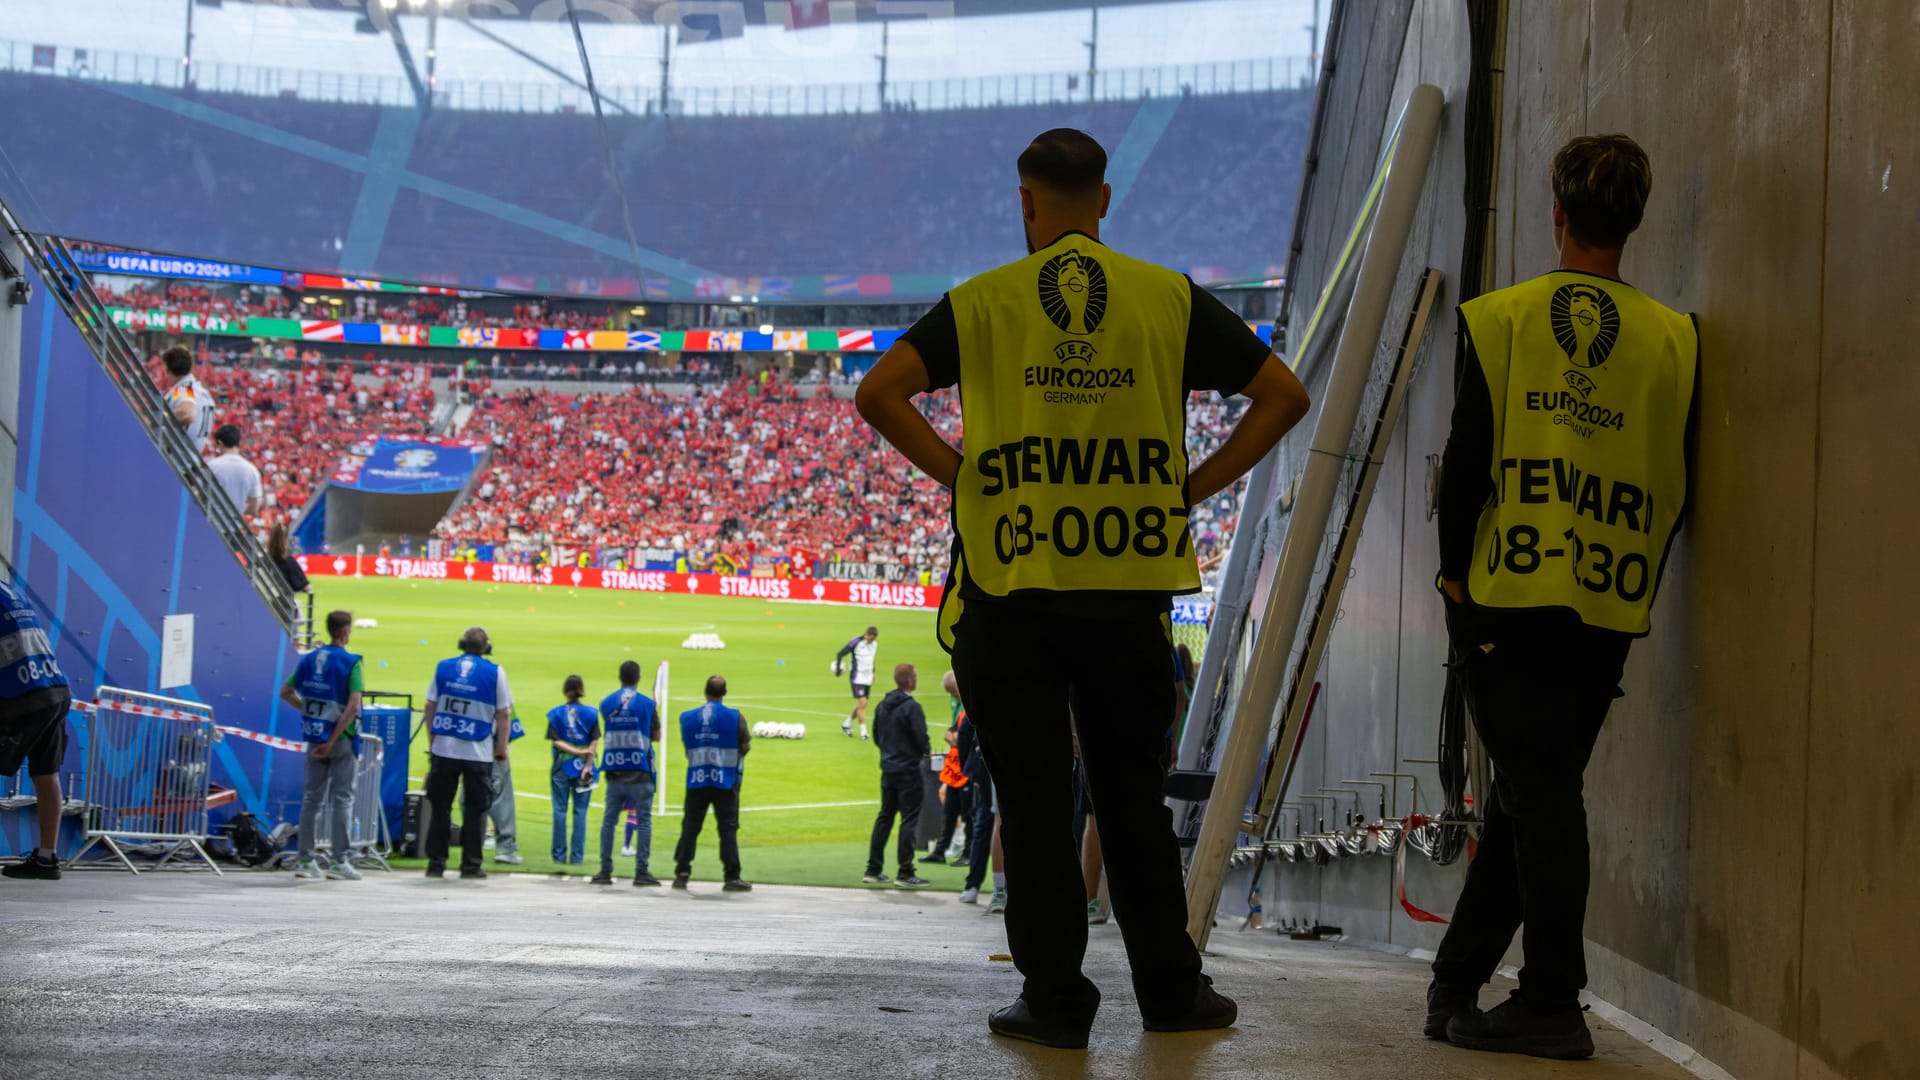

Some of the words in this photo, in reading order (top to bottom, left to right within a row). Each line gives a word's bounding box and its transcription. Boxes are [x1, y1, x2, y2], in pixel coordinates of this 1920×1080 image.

[1055, 344, 1094, 363] UEFA
[1024, 366, 1136, 389] EURO2024
[1565, 374, 1593, 397] EFA
[1044, 391, 1107, 405] GERMANY
[977, 436, 1181, 497] STEWAR
[994, 504, 1189, 565] 08-0087
[376, 557, 447, 578] STRAUSS
[601, 569, 667, 592] STRAUSS
[719, 575, 791, 598] STRAUSS
[848, 582, 926, 606] STRAUSS
[444, 696, 472, 716] ICT
[433, 715, 476, 736] 08-34
[605, 751, 644, 766] 08-0
